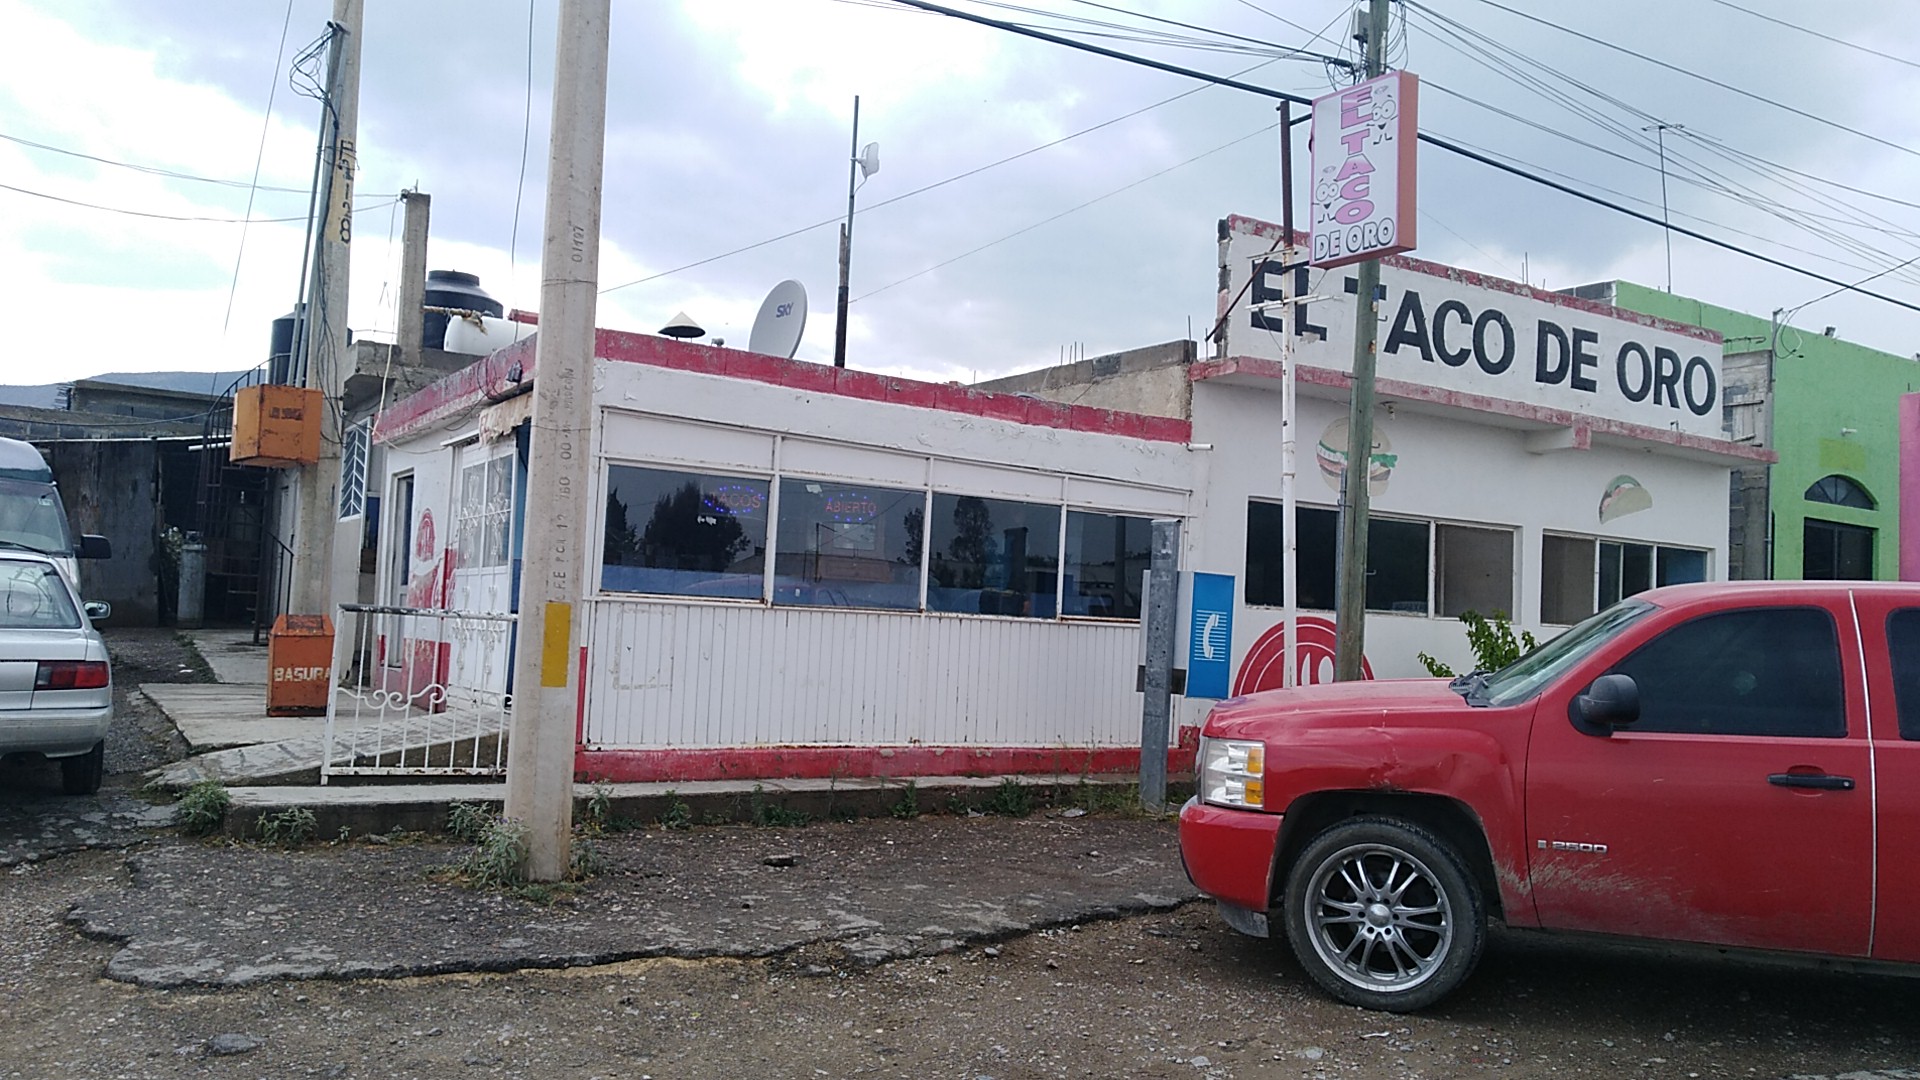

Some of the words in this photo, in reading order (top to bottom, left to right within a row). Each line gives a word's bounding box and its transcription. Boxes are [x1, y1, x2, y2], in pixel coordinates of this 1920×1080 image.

[1341, 86, 1374, 129] EL
[1336, 128, 1376, 224] TACO
[1314, 230, 1341, 261] DE
[1346, 217, 1395, 253] ORO
[775, 302, 795, 318] SKY
[1251, 258, 1327, 342] EL
[1535, 319, 1599, 393] DE
[1616, 340, 1717, 417] ORO
[709, 491, 762, 509] TACOS
[825, 501, 877, 514] ABIERTO
[273, 666, 331, 682] BASURA
[1552, 841, 1608, 854] 2500
